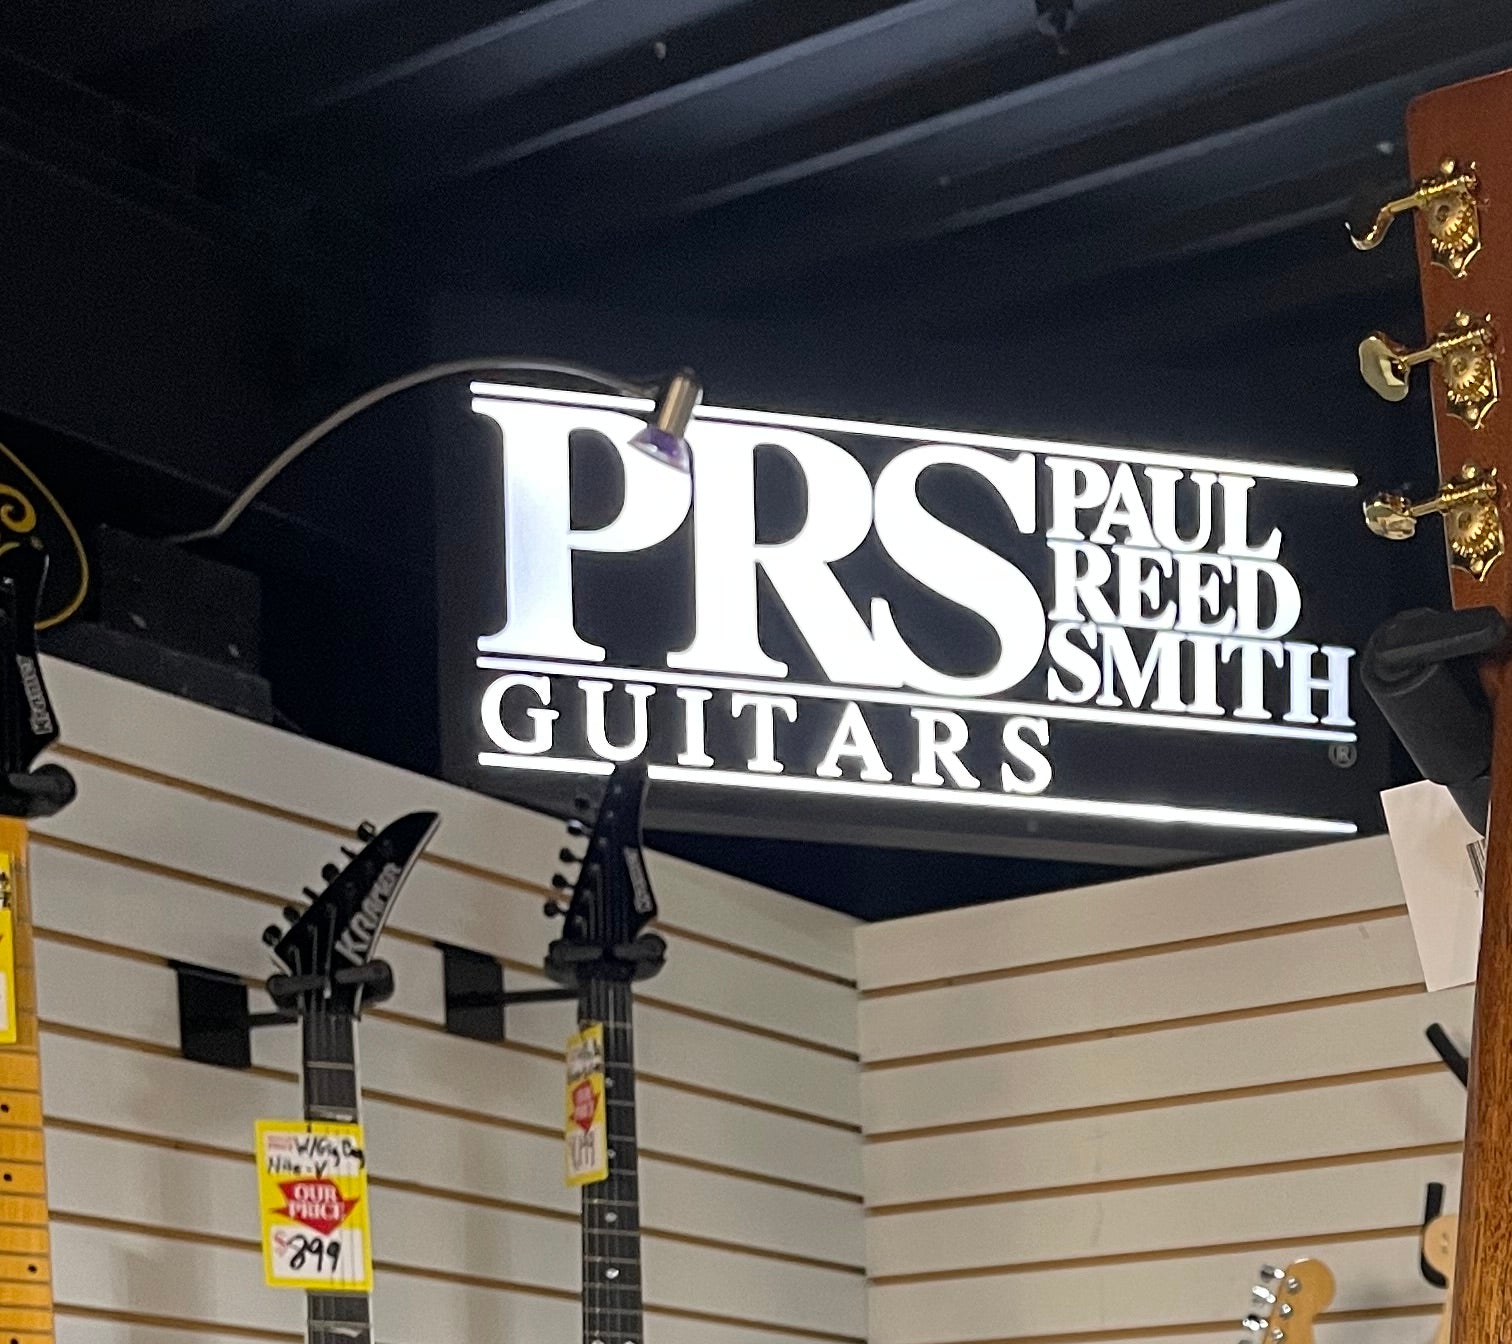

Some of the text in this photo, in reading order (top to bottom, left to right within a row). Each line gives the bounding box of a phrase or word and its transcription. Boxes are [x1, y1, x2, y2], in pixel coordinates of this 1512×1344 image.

[471, 396, 1047, 698] PRS
[1045, 456, 1282, 558] PAUL
[1047, 538, 1302, 641] REED
[1046, 622, 1356, 727] SMITH
[480, 673, 1052, 795] GUITARS
[289, 1200, 345, 1221] PRICE
[294, 1183, 337, 1201] OUR
